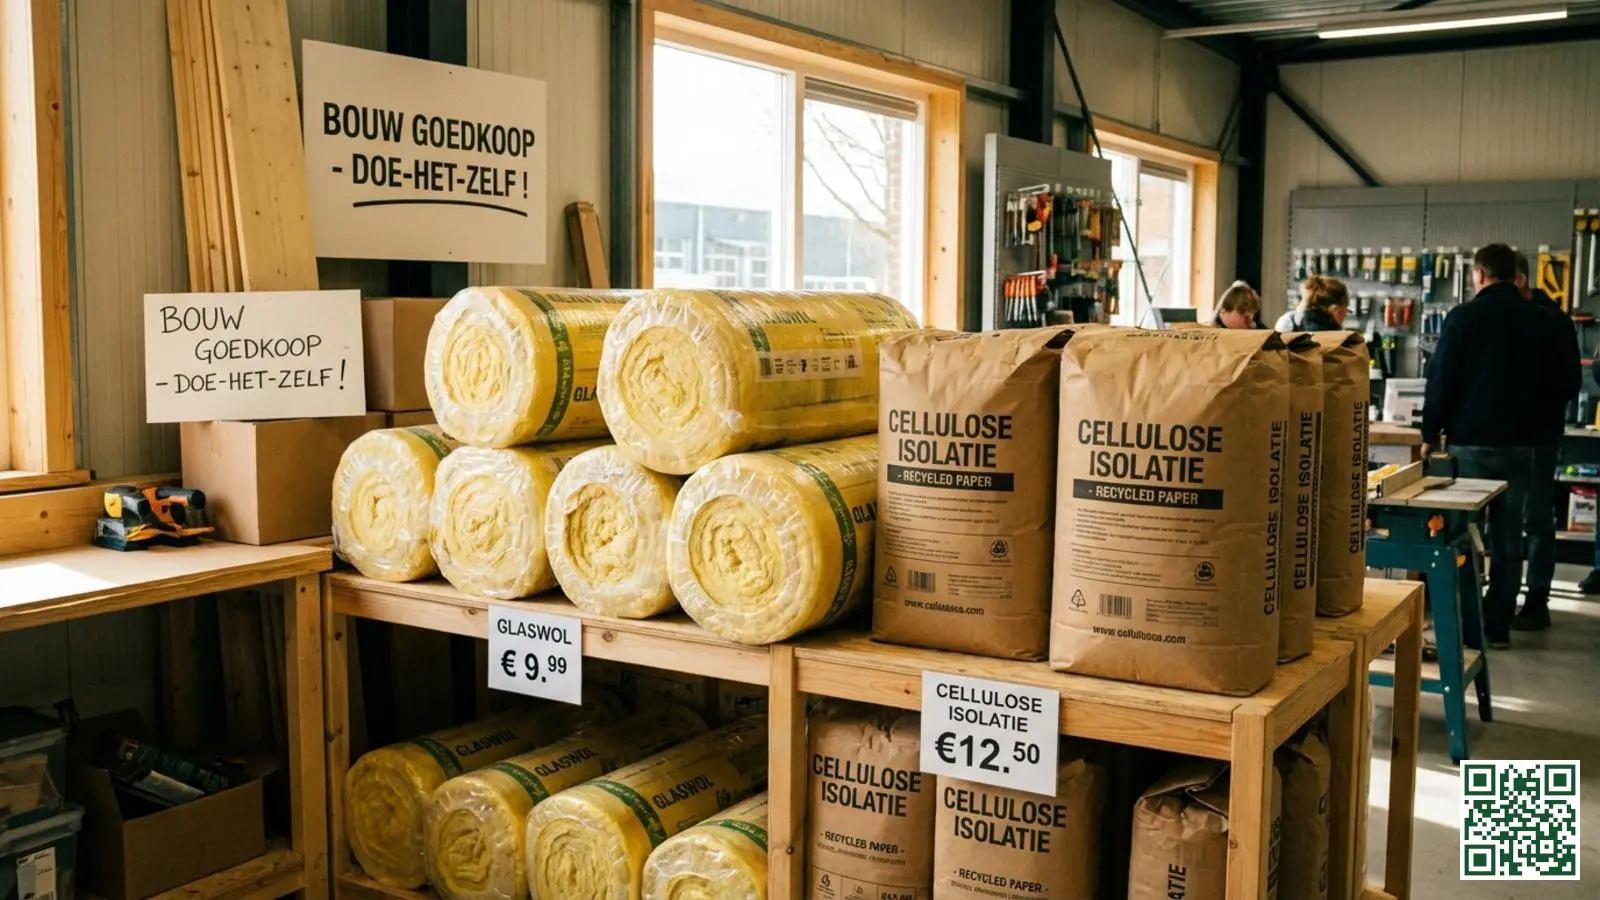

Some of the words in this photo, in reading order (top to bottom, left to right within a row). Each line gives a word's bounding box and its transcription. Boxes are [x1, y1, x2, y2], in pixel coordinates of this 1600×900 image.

[323, 101, 404, 143] BOUW
[412, 113, 535, 158] GOEDKOOP
[160, 305, 244, 334] BOUW
[195, 334, 321, 365] GOEDKOOP
[888, 408, 1013, 441] CELLULOSE
[1078, 418, 1223, 453] CELLULOSE
[898, 437, 997, 469] ISOLATIE
[1298, 411, 1313, 487] ISOLATIE
[955, 474, 993, 489] PAPER
[1089, 450, 1205, 484] ISOLATIE
[1095, 485, 1154, 502] RECYCLED
[1158, 490, 1199, 505] PAPER
[497, 618, 572, 645] GLASWOL
[936, 683, 1042, 714] CELLULOSE
[949, 705, 1028, 733] ISOLATIE
[534, 746, 599, 777] GLASWOL
[935, 731, 1040, 774] €12.50
[812, 753, 921, 793] CELLULOSE
[653, 774, 715, 809] GLASWOL
[821, 780, 907, 818] ISOLATIE
[944, 786, 1067, 828] CELLULOSE
[954, 815, 1051, 853] ISOLATIE
[1009, 879, 1042, 893] PAPER
